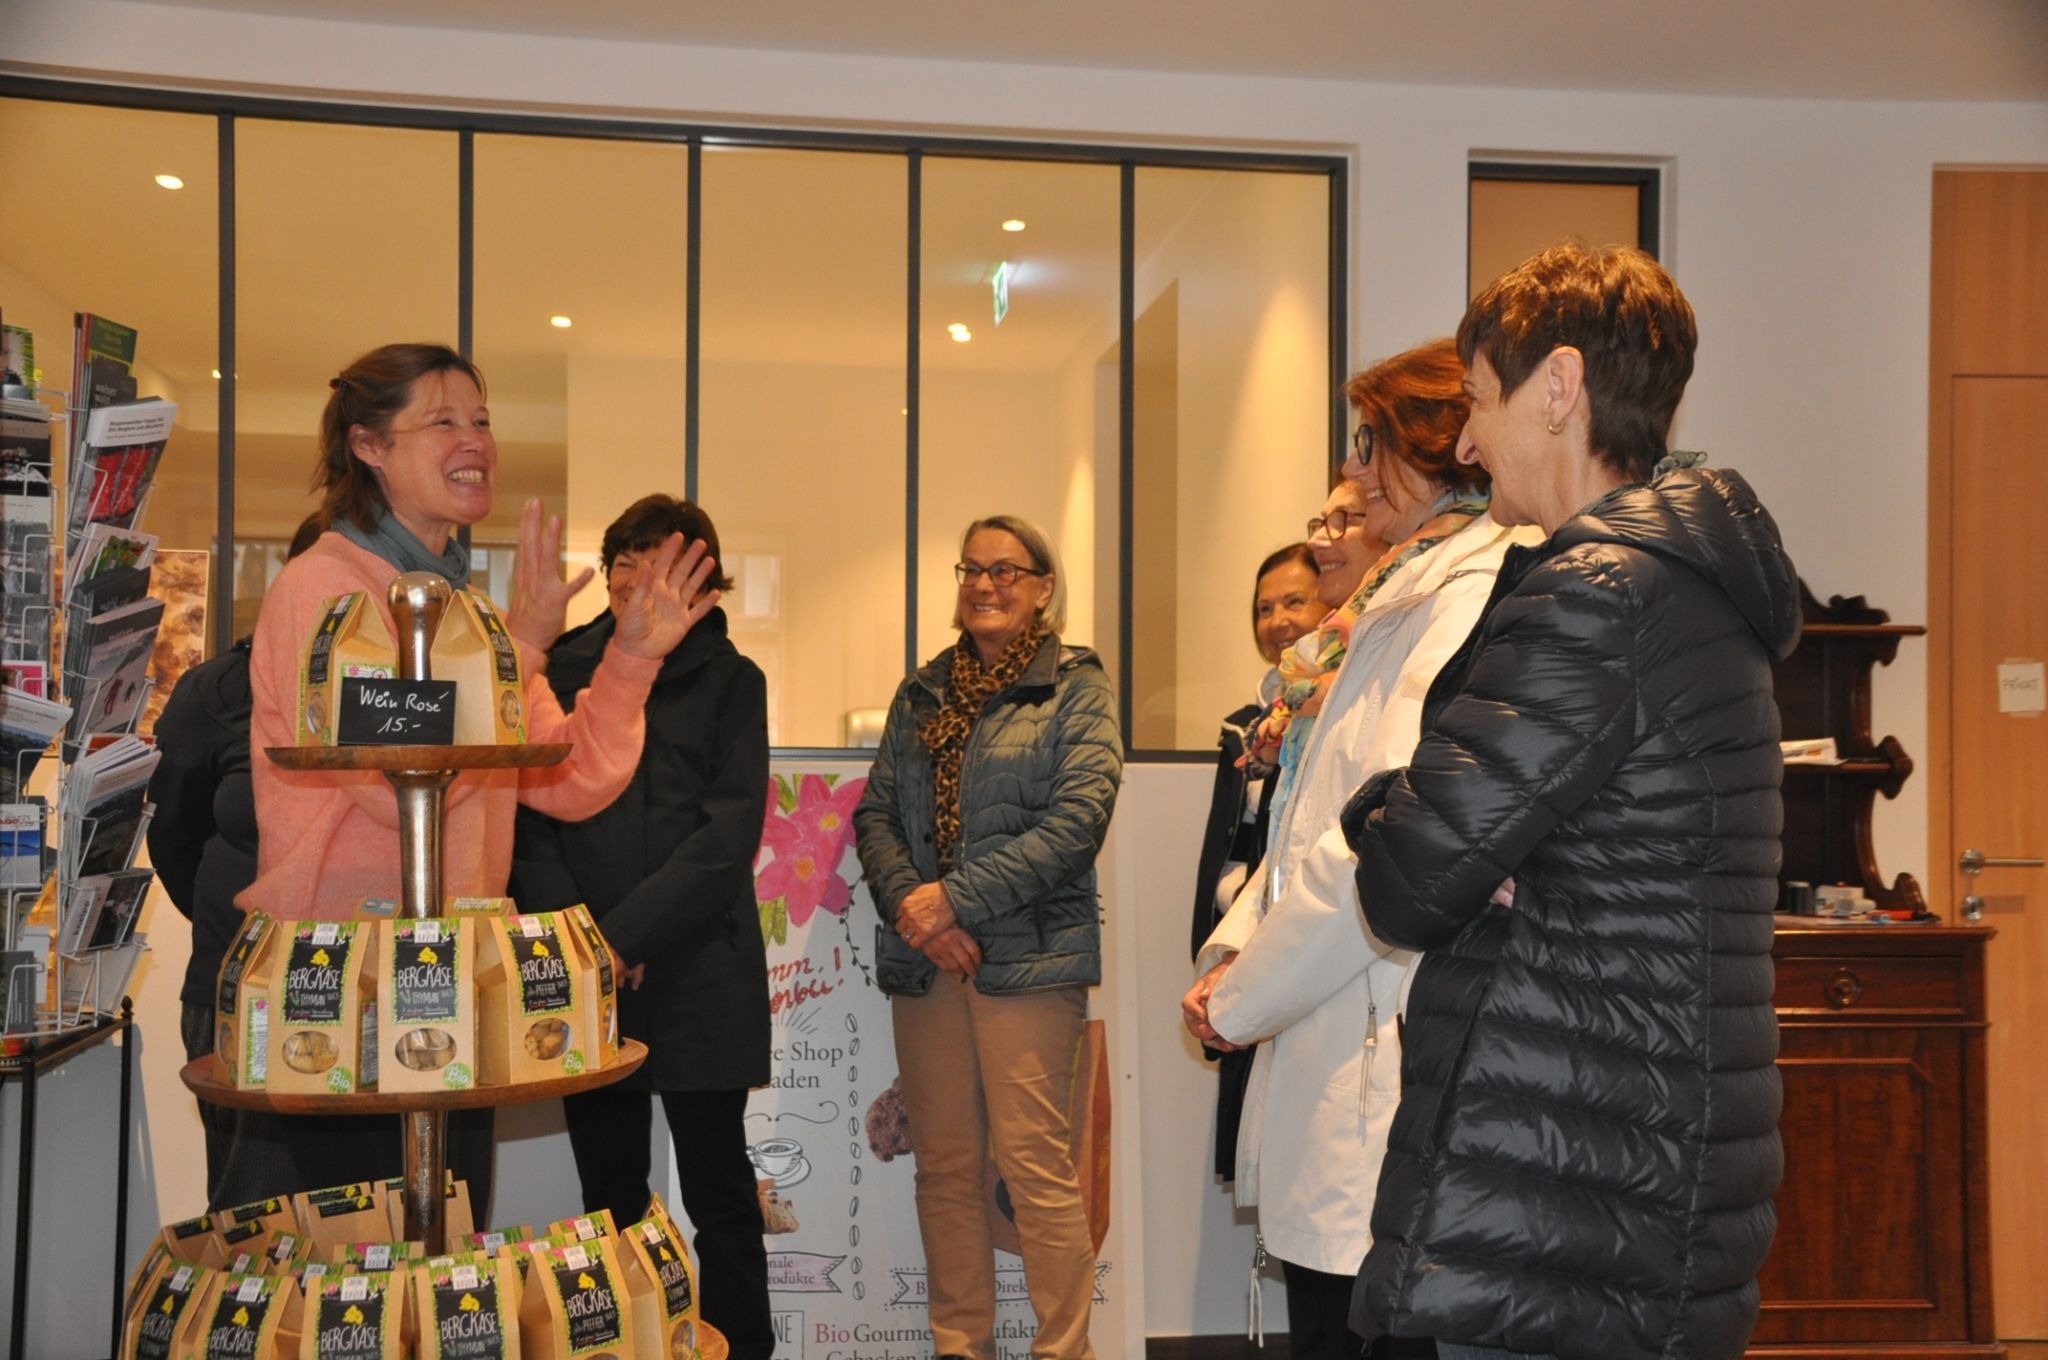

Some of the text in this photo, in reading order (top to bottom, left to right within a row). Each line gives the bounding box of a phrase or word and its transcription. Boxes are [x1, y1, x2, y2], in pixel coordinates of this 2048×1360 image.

[361, 684, 450, 712] Wein Rosé
[565, 1055, 582, 1069] Bio
[790, 1041, 843, 1067] Shop
[330, 1072, 350, 1089] Bio
[447, 1067, 469, 1084] Bio
[771, 1068, 820, 1089] aden
[769, 1255, 794, 1269] nale
[768, 1271, 815, 1285] rodukte
[815, 1323, 934, 1344] BioGourme
